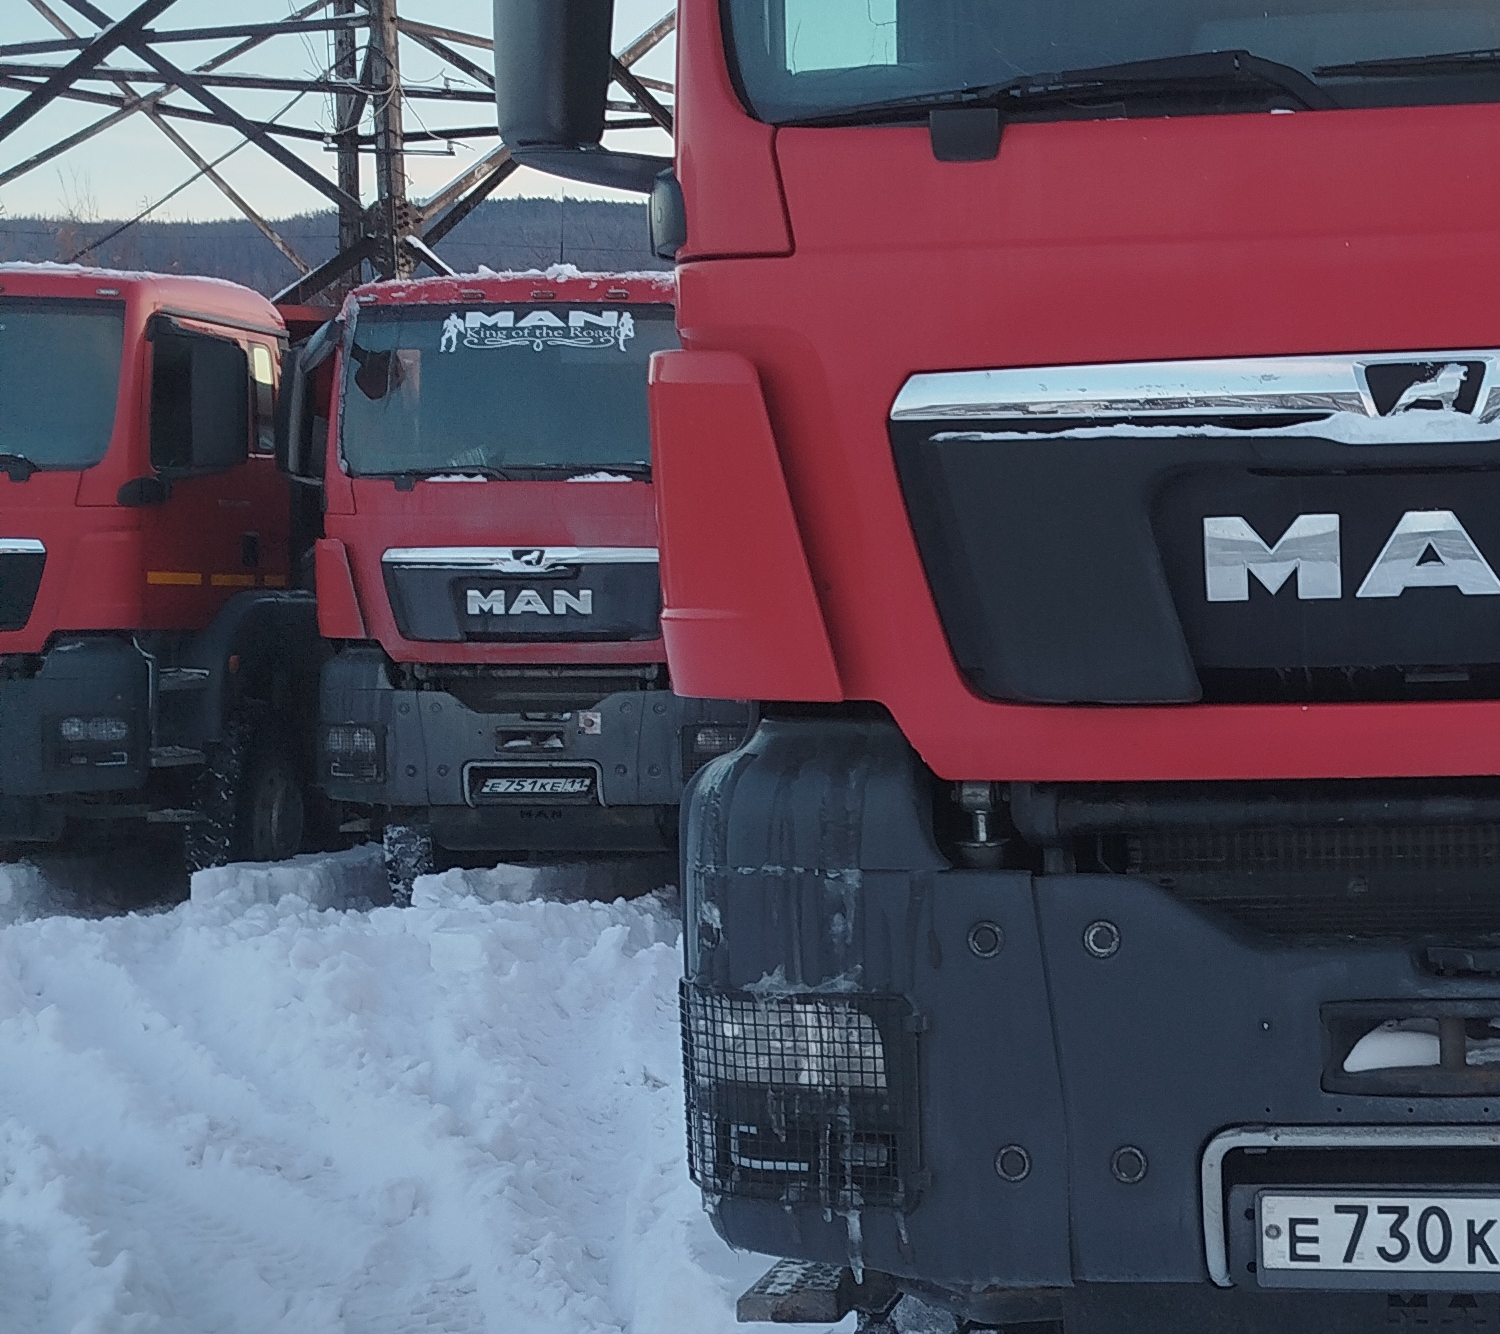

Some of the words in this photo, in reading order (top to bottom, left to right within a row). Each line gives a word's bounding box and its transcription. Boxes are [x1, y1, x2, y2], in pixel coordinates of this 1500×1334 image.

[465, 310, 618, 328] MAN
[466, 327, 507, 340] King
[511, 327, 531, 338] of
[535, 327, 564, 338] the
[570, 327, 617, 338] Road
[466, 589, 594, 615] MAN
[519, 809, 562, 819] MAN
